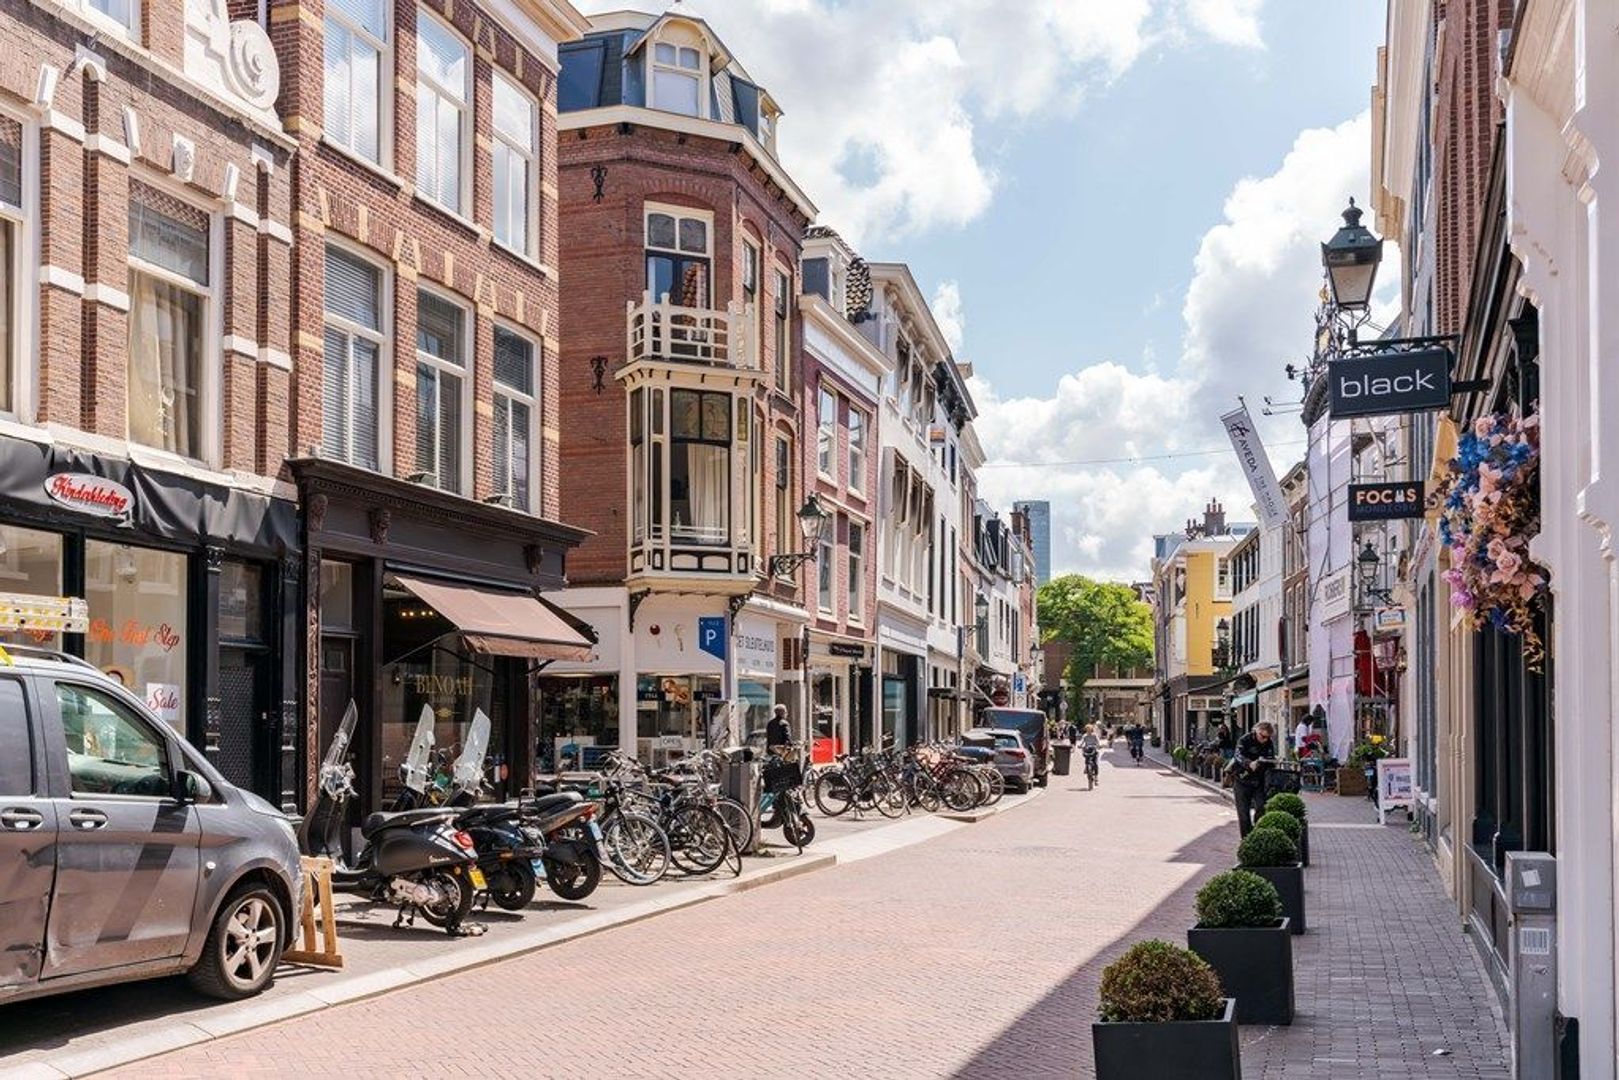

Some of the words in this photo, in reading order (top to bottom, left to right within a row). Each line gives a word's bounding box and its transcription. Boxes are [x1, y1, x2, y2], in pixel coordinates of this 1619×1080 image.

[1341, 369, 1435, 398] black
[1239, 440, 1257, 473] AVEDA
[1356, 488, 1417, 505] FOCUS
[706, 629, 717, 646] P
[148, 688, 178, 711] Sale
